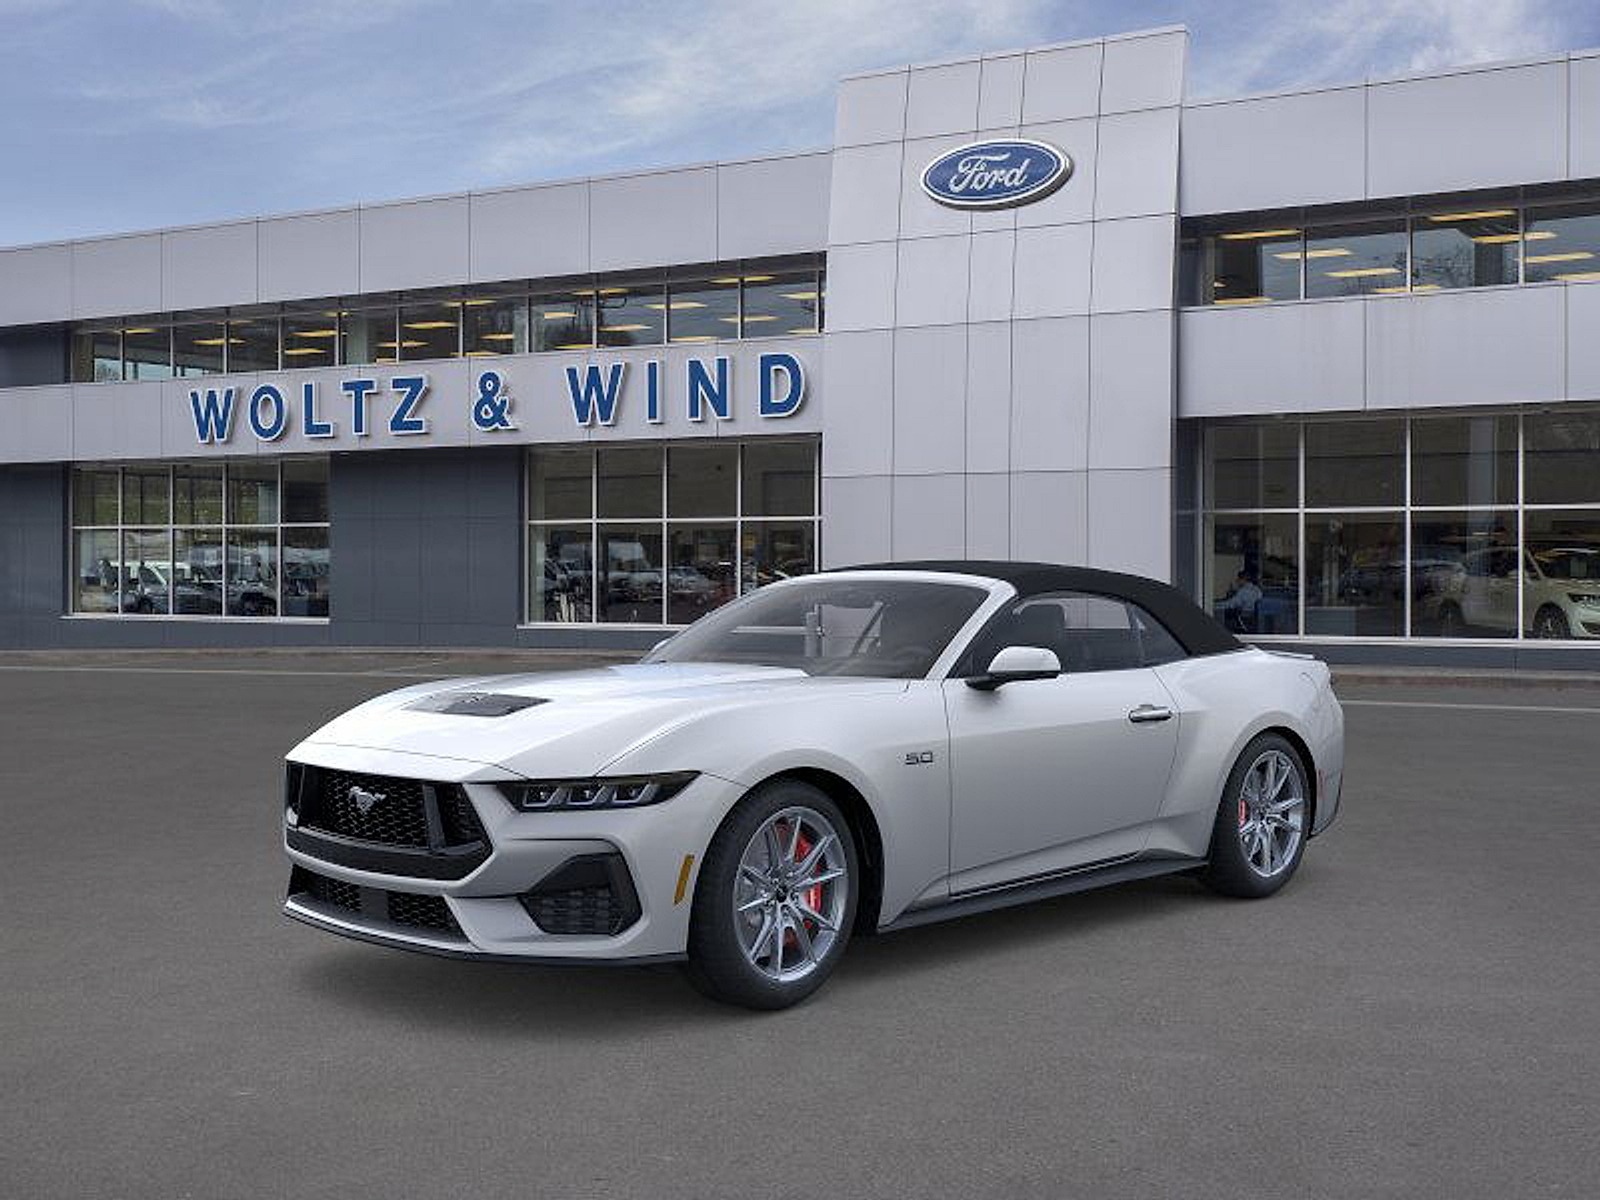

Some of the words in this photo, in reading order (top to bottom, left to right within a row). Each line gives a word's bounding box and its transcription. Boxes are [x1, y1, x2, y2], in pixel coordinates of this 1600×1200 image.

[949, 152, 1031, 193] Ford
[190, 375, 431, 444] WOLTZ
[472, 371, 516, 431] &
[565, 352, 807, 426] WIND
